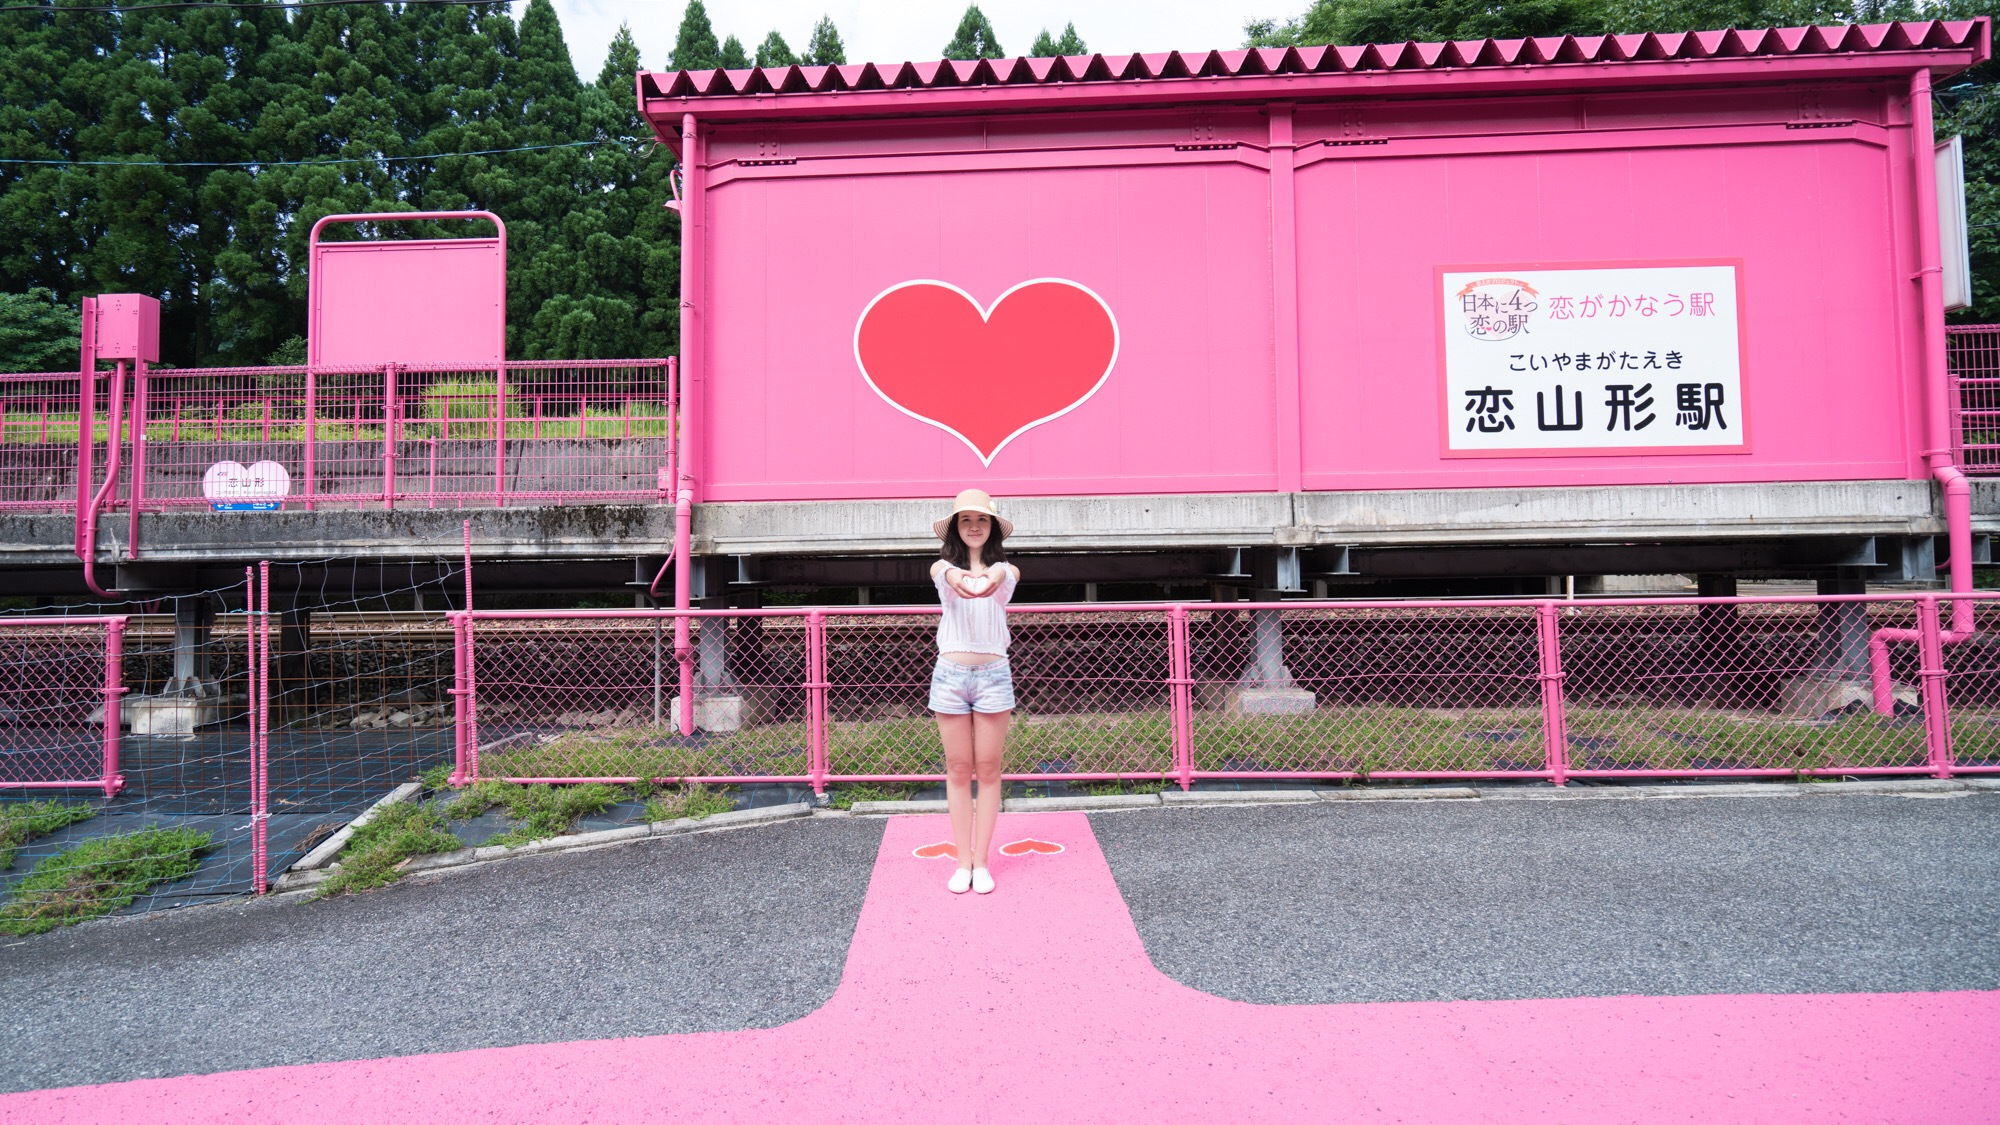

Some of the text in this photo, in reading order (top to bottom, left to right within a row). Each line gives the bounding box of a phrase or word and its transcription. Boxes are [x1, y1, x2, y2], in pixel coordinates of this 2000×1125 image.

[1463, 289, 1538, 314] 日本に4つ
[1549, 292, 1716, 320] 恋がかなう駅
[1470, 314, 1530, 335] 恋の駅
[1509, 350, 1683, 371] こいやまがたえき
[1465, 382, 1727, 433] 恋山形駅
[228, 478, 264, 487] 恋山形
